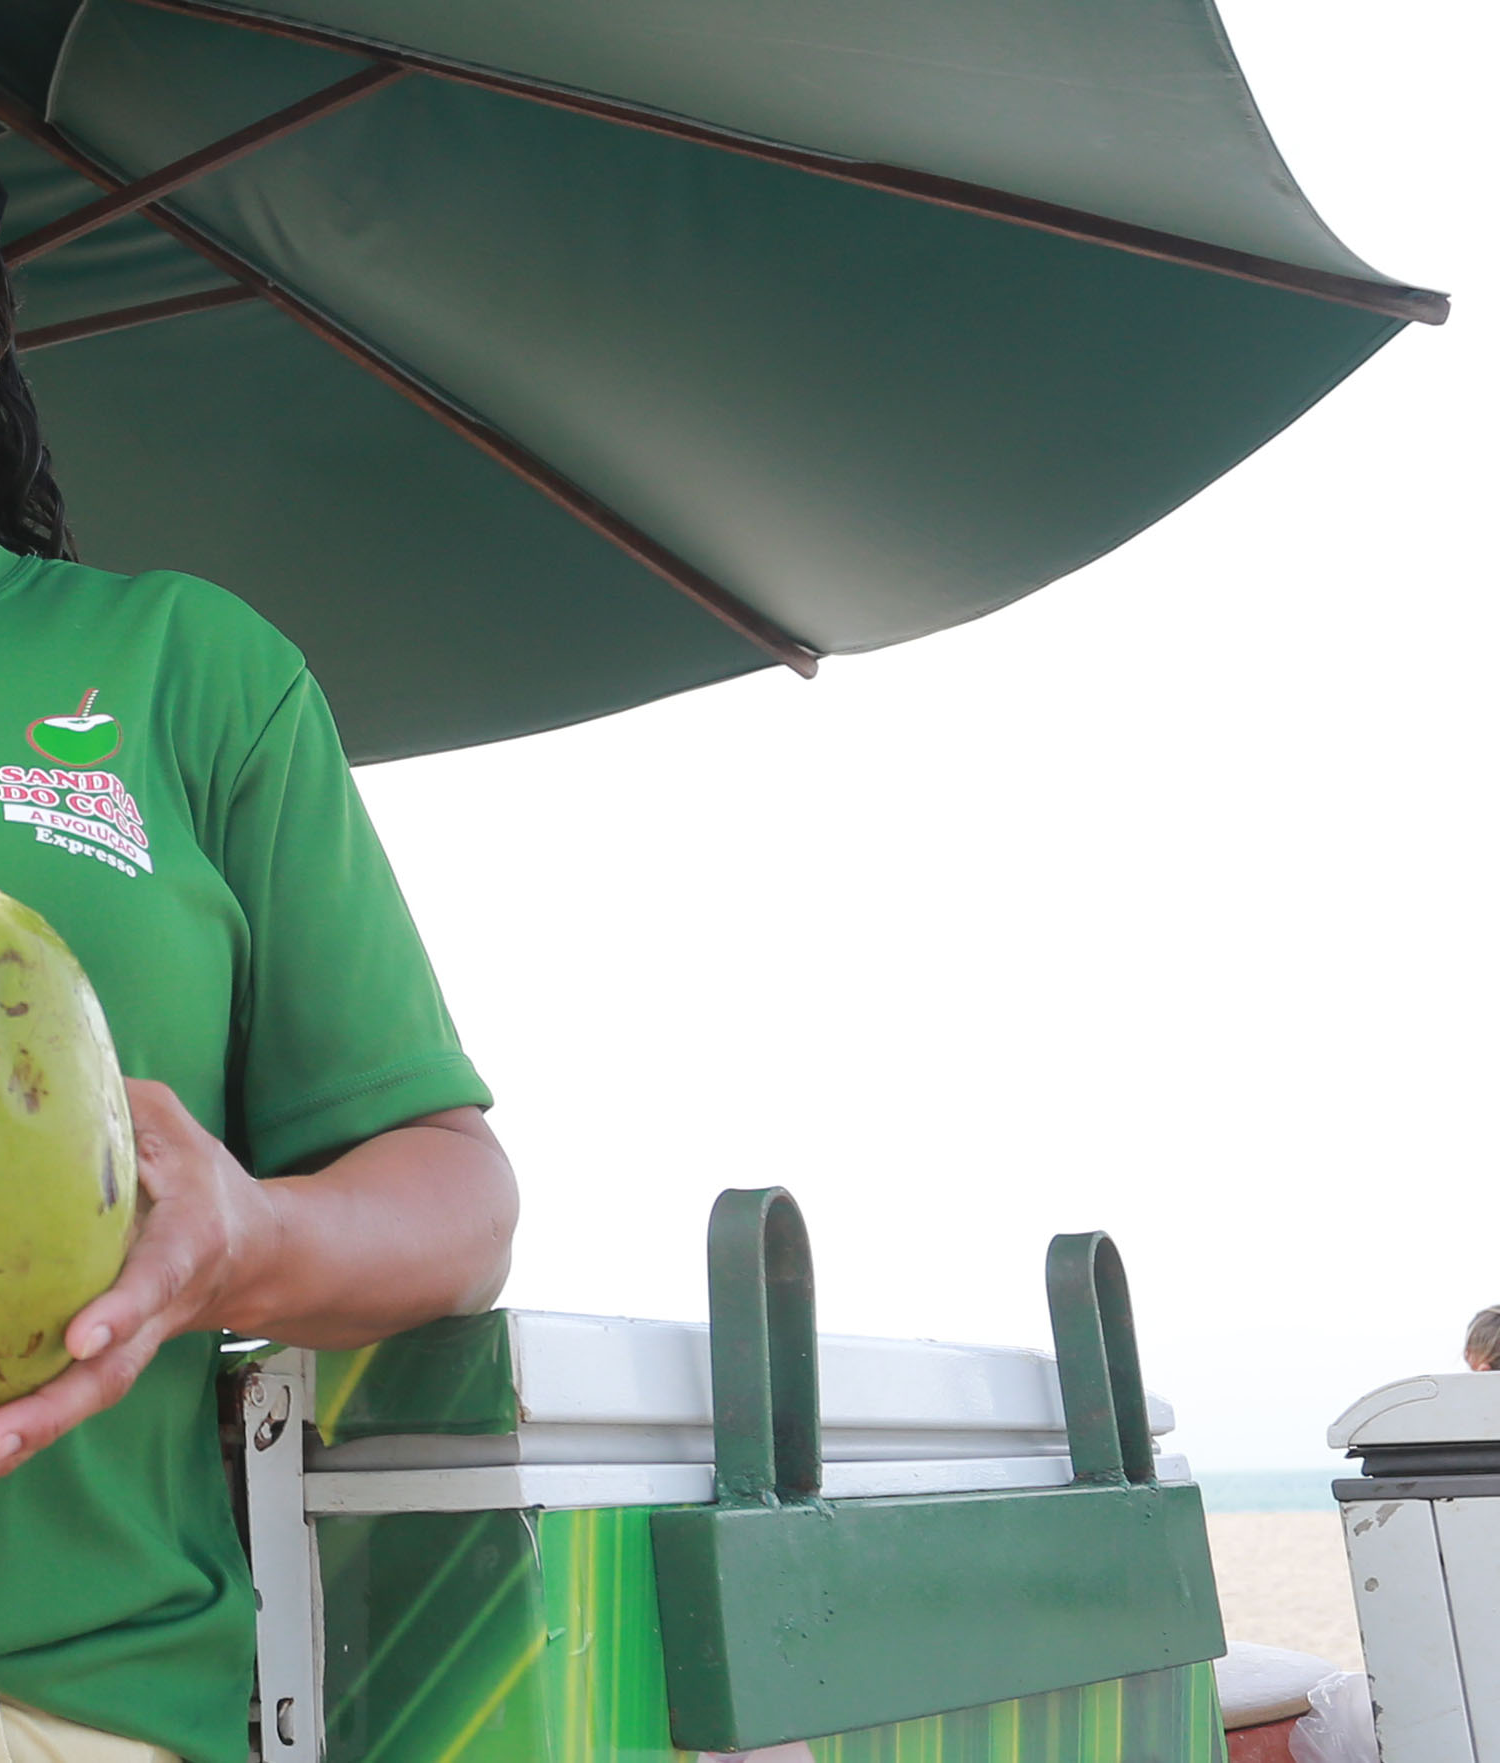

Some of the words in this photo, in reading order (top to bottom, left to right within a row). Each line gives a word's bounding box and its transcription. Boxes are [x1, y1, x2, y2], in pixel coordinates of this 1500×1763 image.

[30, 810, 44, 821] A
[66, 793, 149, 849] COCO
[35, 827, 137, 878] Expresso
